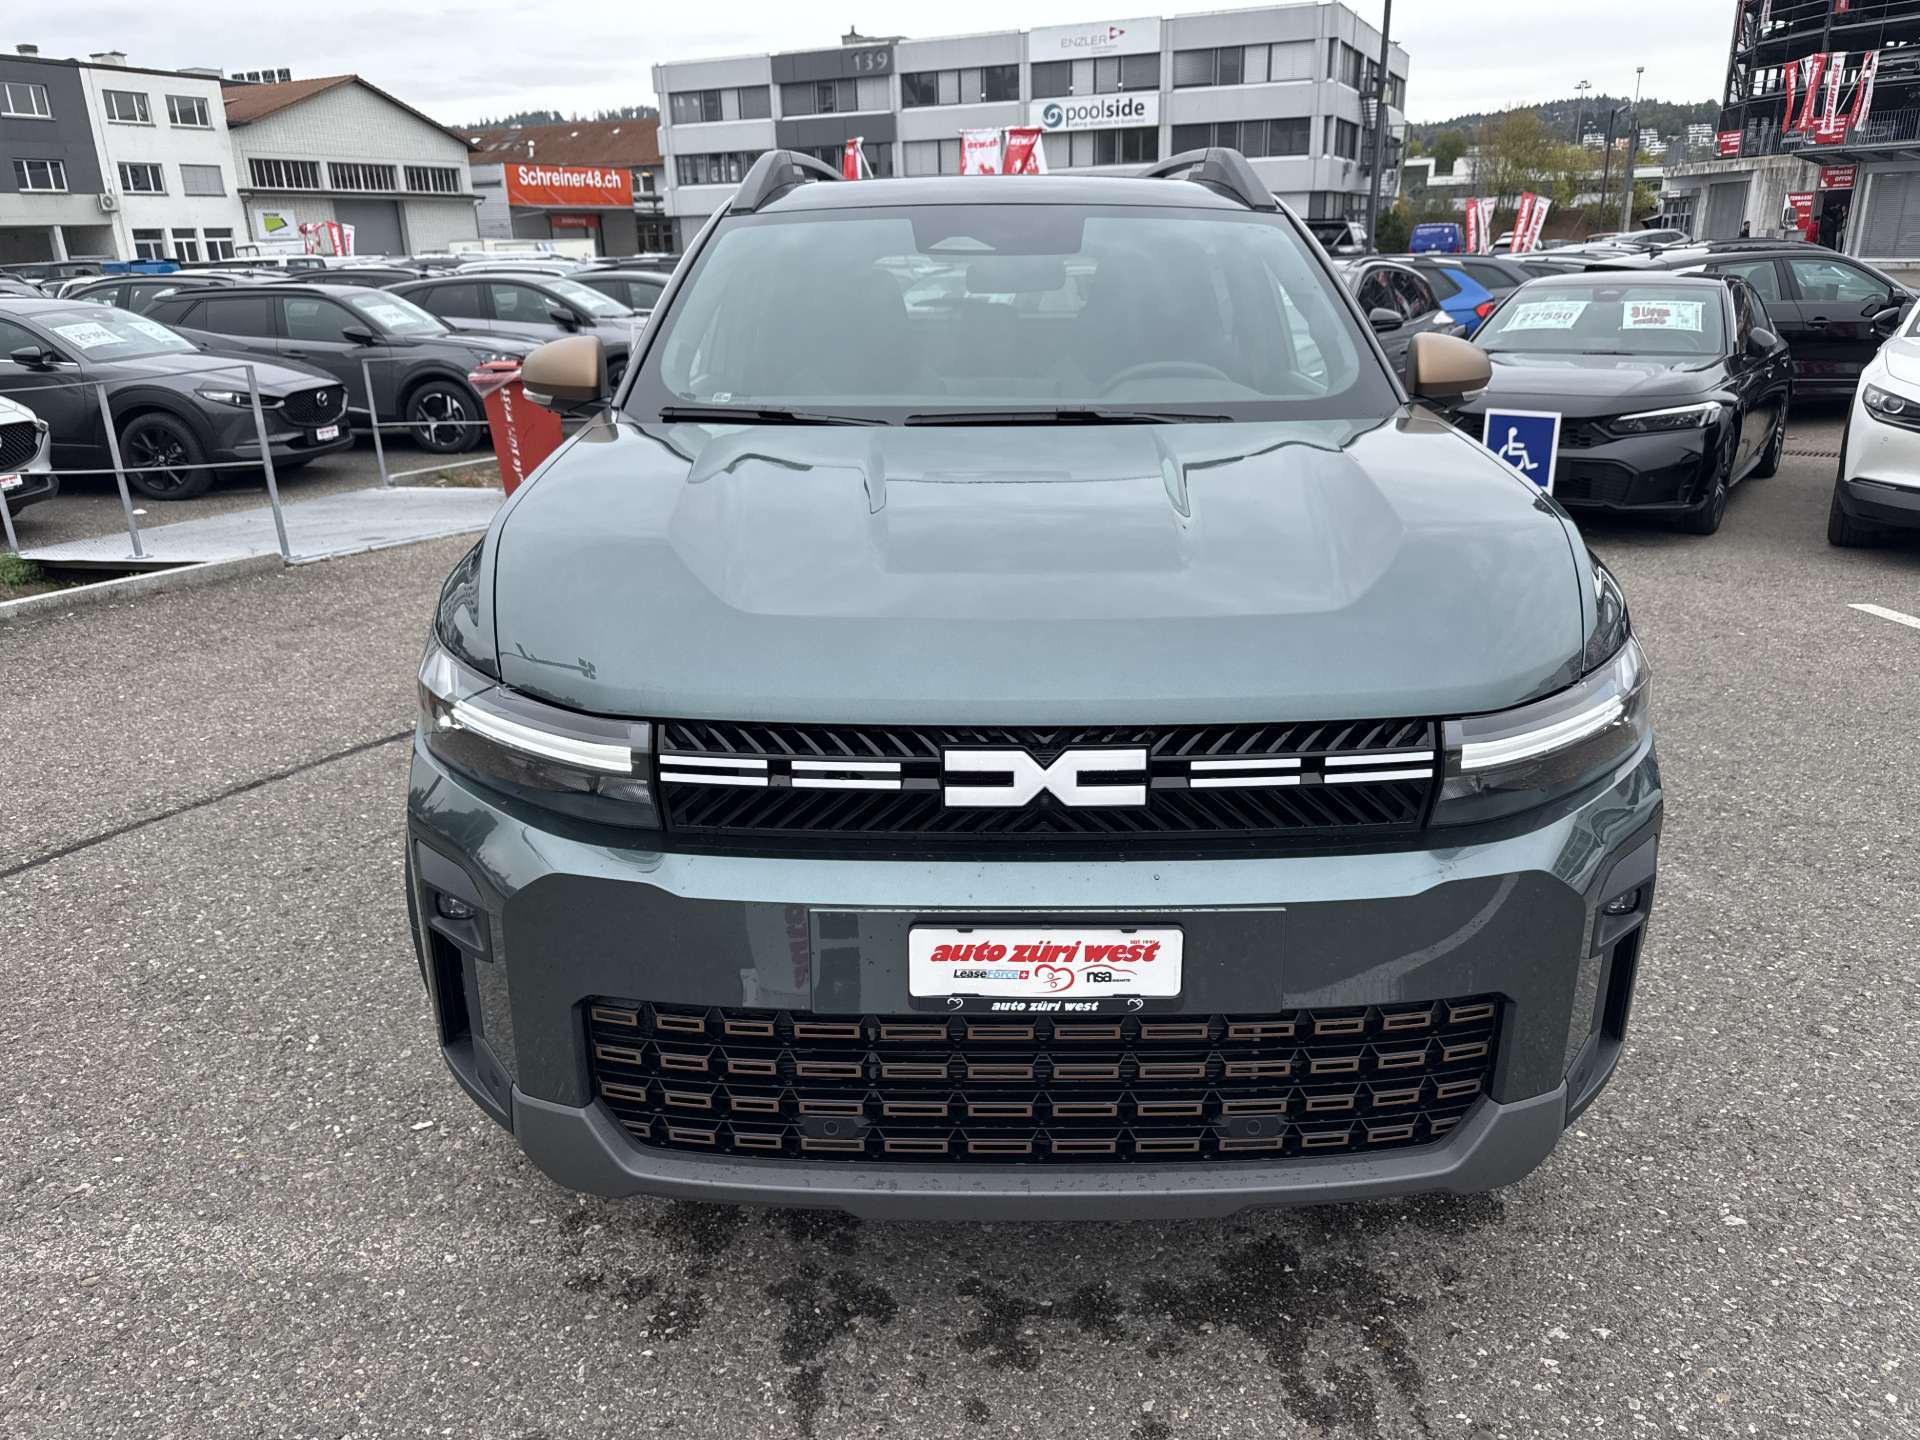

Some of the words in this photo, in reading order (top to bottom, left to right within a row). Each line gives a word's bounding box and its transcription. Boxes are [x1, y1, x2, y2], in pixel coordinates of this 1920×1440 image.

[1060, 34, 1108, 49] ENZLER
[853, 50, 889, 72] 139
[1065, 97, 1145, 128] poolside
[518, 165, 622, 189] Schreiner48.ch
[930, 940, 1007, 963] auto
[1007, 940, 1082, 963] züri
[1084, 940, 1161, 963] west
[1086, 971, 1112, 983] nsa
[991, 1001, 1026, 1011] auto
[1027, 1001, 1062, 1012] züri
[1064, 1001, 1099, 1012] west
